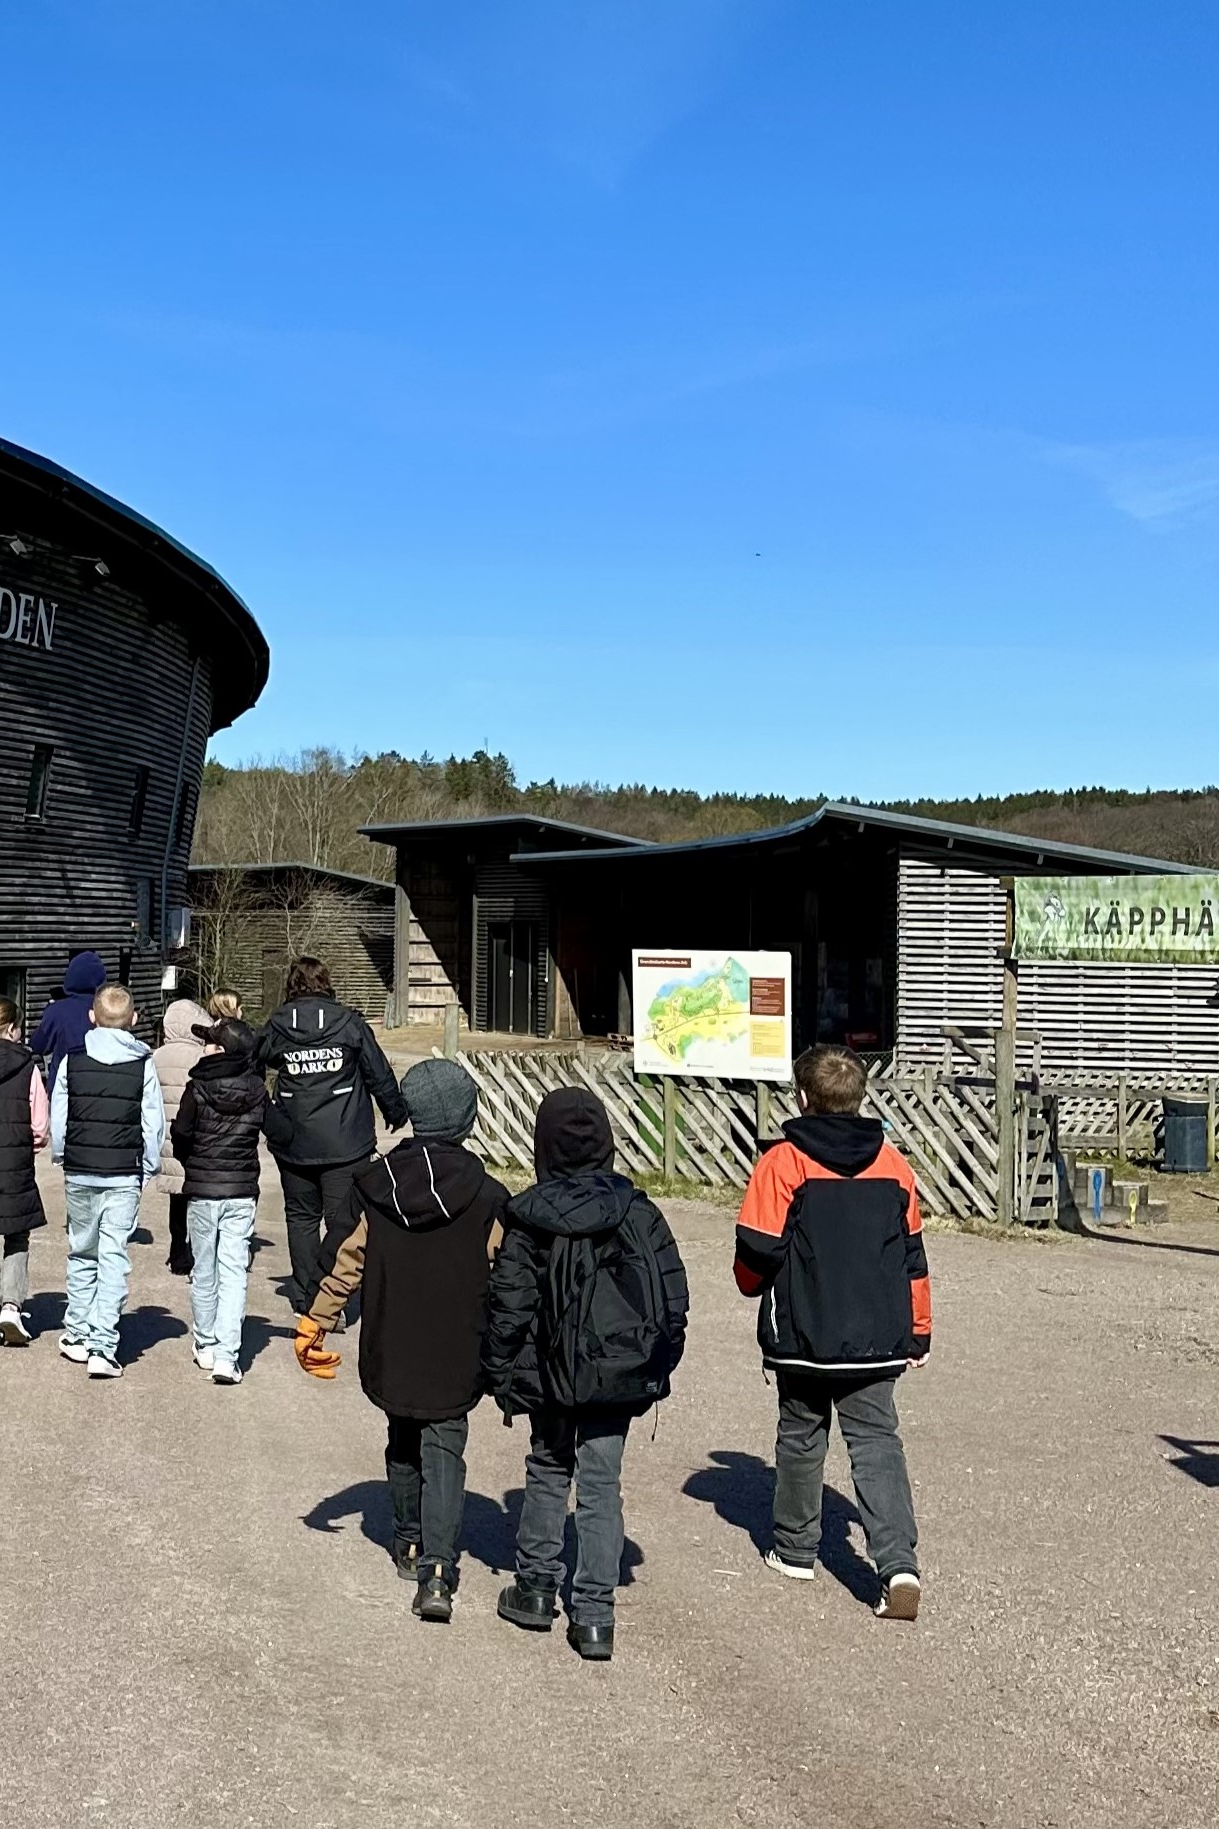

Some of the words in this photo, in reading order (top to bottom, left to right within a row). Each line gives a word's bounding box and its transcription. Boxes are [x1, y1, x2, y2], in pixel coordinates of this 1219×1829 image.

[1084, 899, 1214, 936] KÄPPHÄ
[283, 1047, 343, 1062] NORDENS
[301, 1061, 328, 1074] ARK
